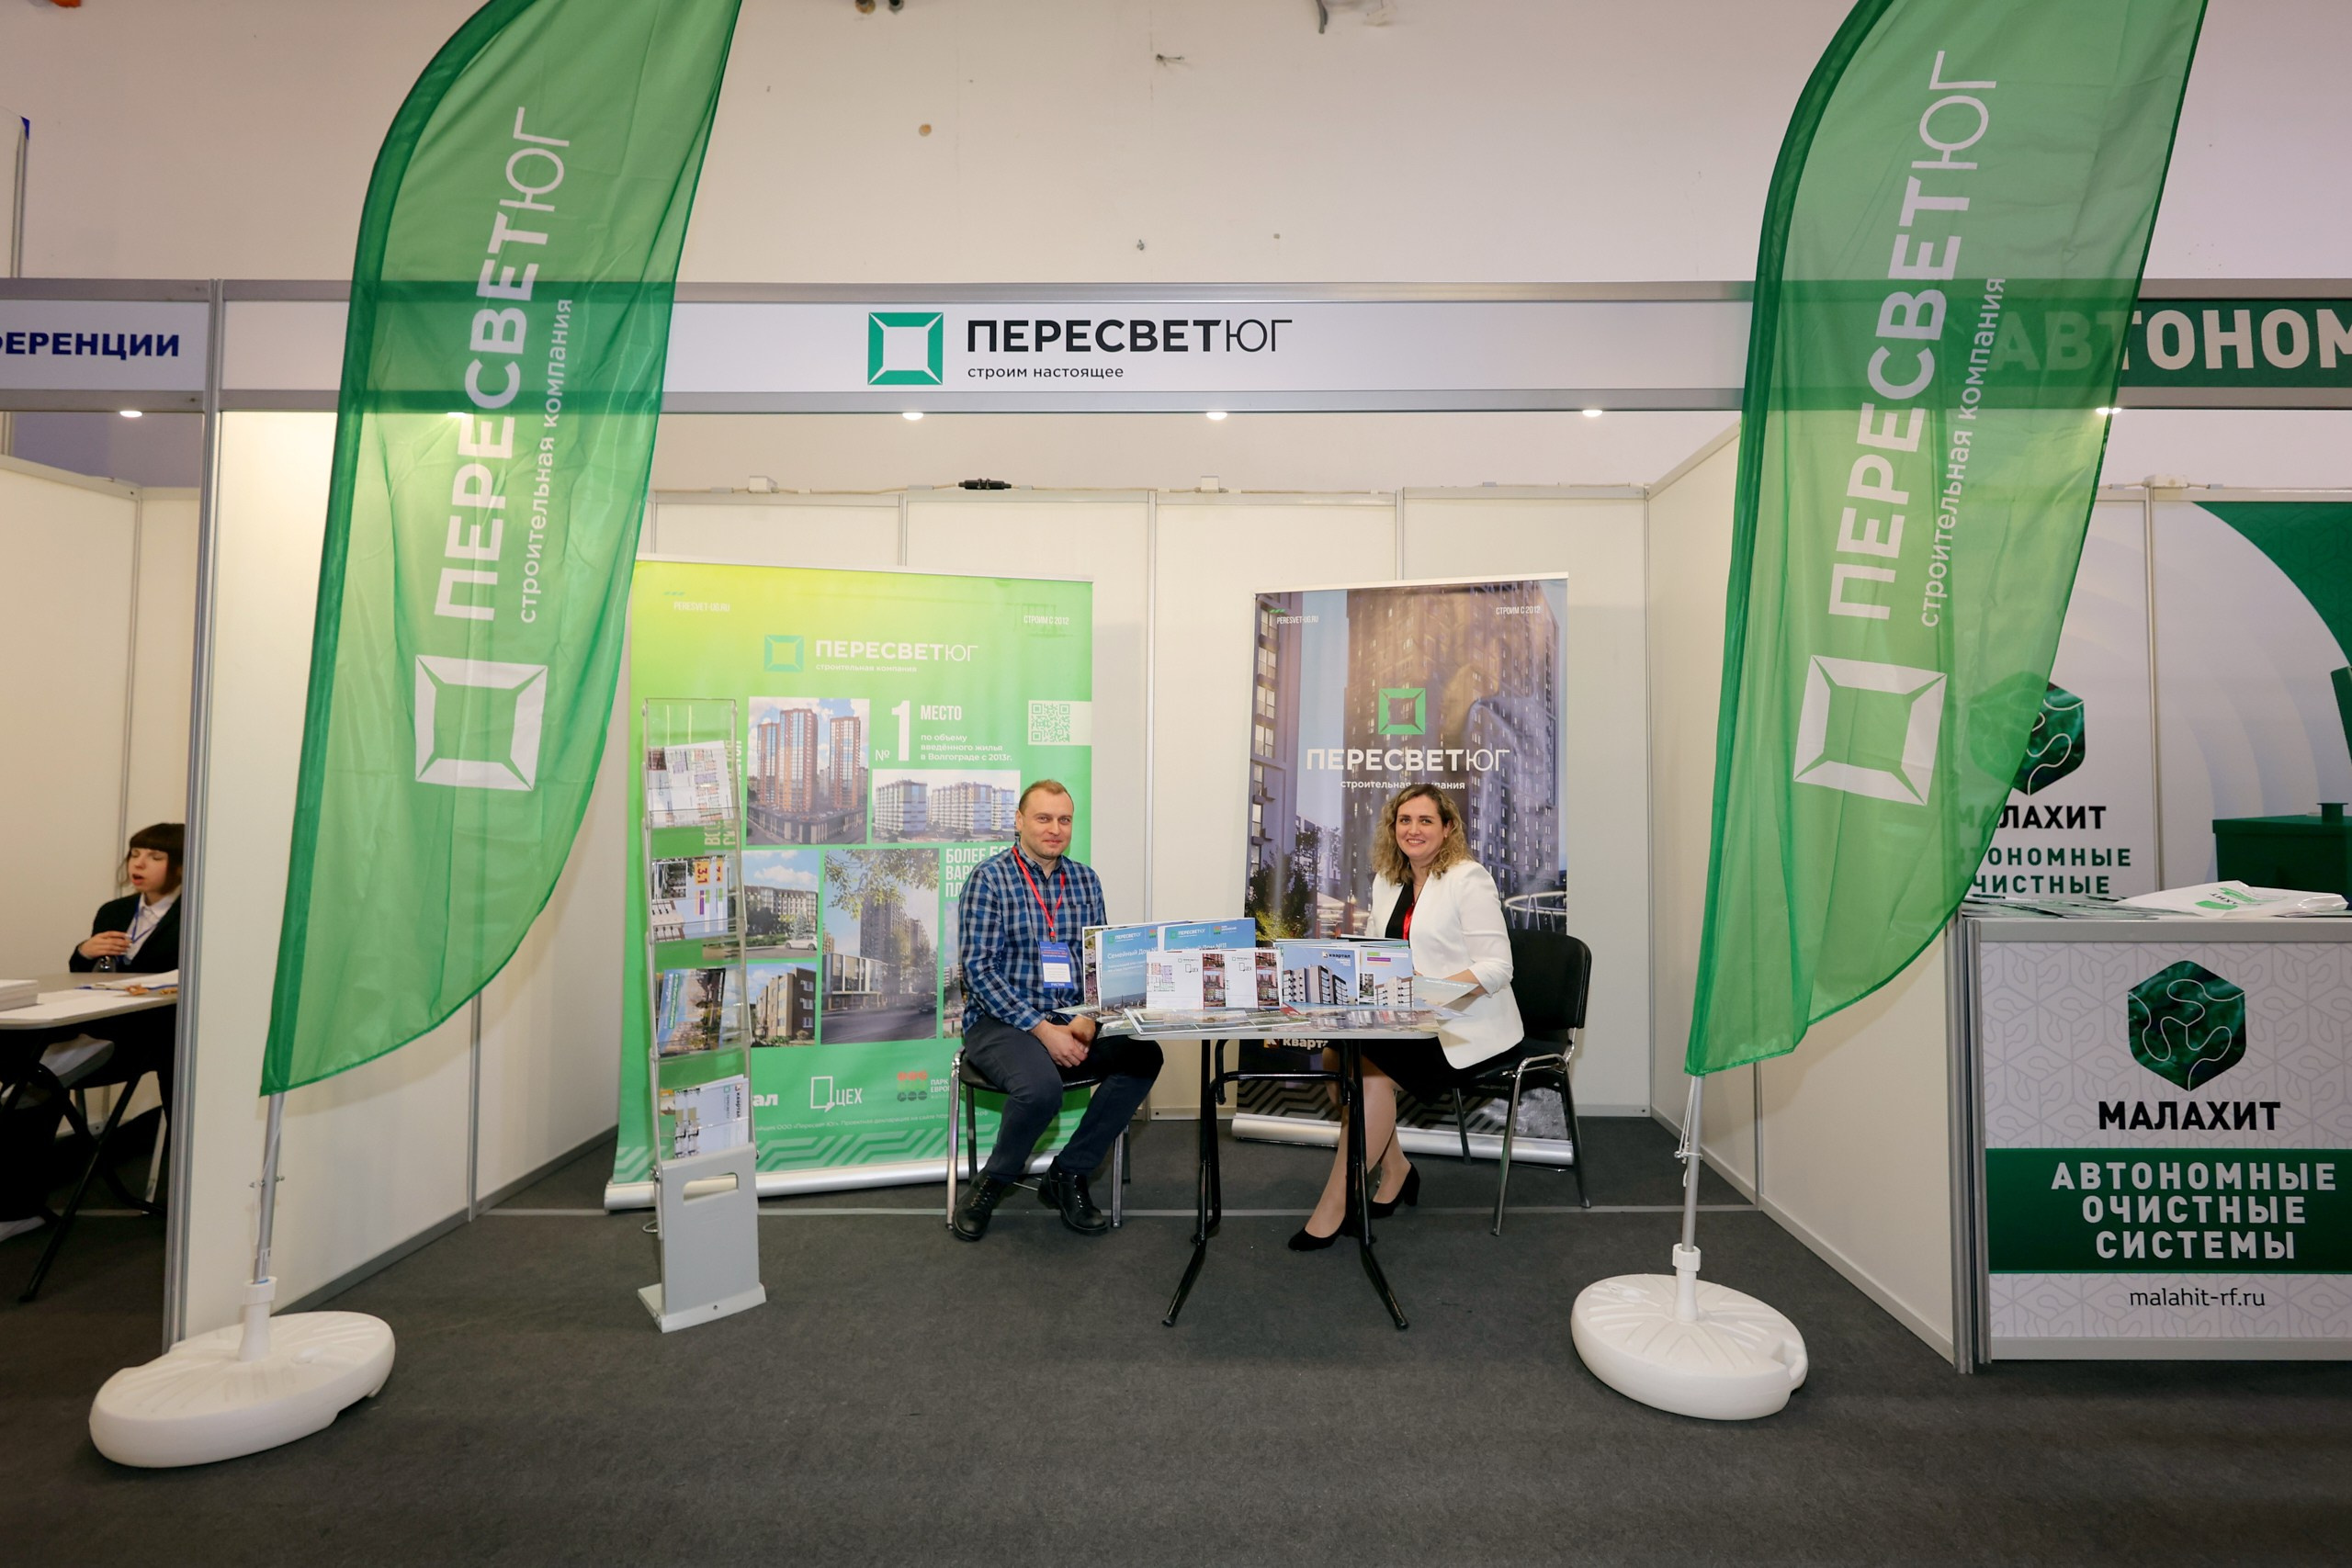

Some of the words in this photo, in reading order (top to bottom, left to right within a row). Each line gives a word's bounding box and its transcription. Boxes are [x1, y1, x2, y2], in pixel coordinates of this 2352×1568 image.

[0, 332, 179, 360] ЕРЕНЦИИ
[967, 367, 1028, 379] строим
[1034, 367, 1124, 379] настоящее
[522, 436, 555, 623] строительная
[543, 299, 573, 427] компания
[1922, 431, 1973, 626] строительная
[1958, 277, 2006, 420] компания
[1496, 606, 1519, 615] СТРОИМ
[1525, 605, 1541, 614] 2012
[1023, 615, 1047, 625] СТРОИМ
[1276, 615, 1319, 625] PERESVET-UG.RU
[816, 663, 875, 671] строительная
[876, 664, 917, 673] компания
[921, 705, 962, 721] МЕСТО
[928, 753, 979, 761] Волгограде
[836, 1088, 864, 1107] ЦЕХ
[2098, 1101, 2281, 1131] МАЛАХИТ
[2051, 1162, 2336, 1191] АВТОНОМНЫЕ
[2082, 1196, 2306, 1224] ОЧИСТНЫЕ
[2096, 1231, 2295, 1259] СИСТЕМЫ
[2130, 1287, 2266, 1307] malahit-rf.ru
